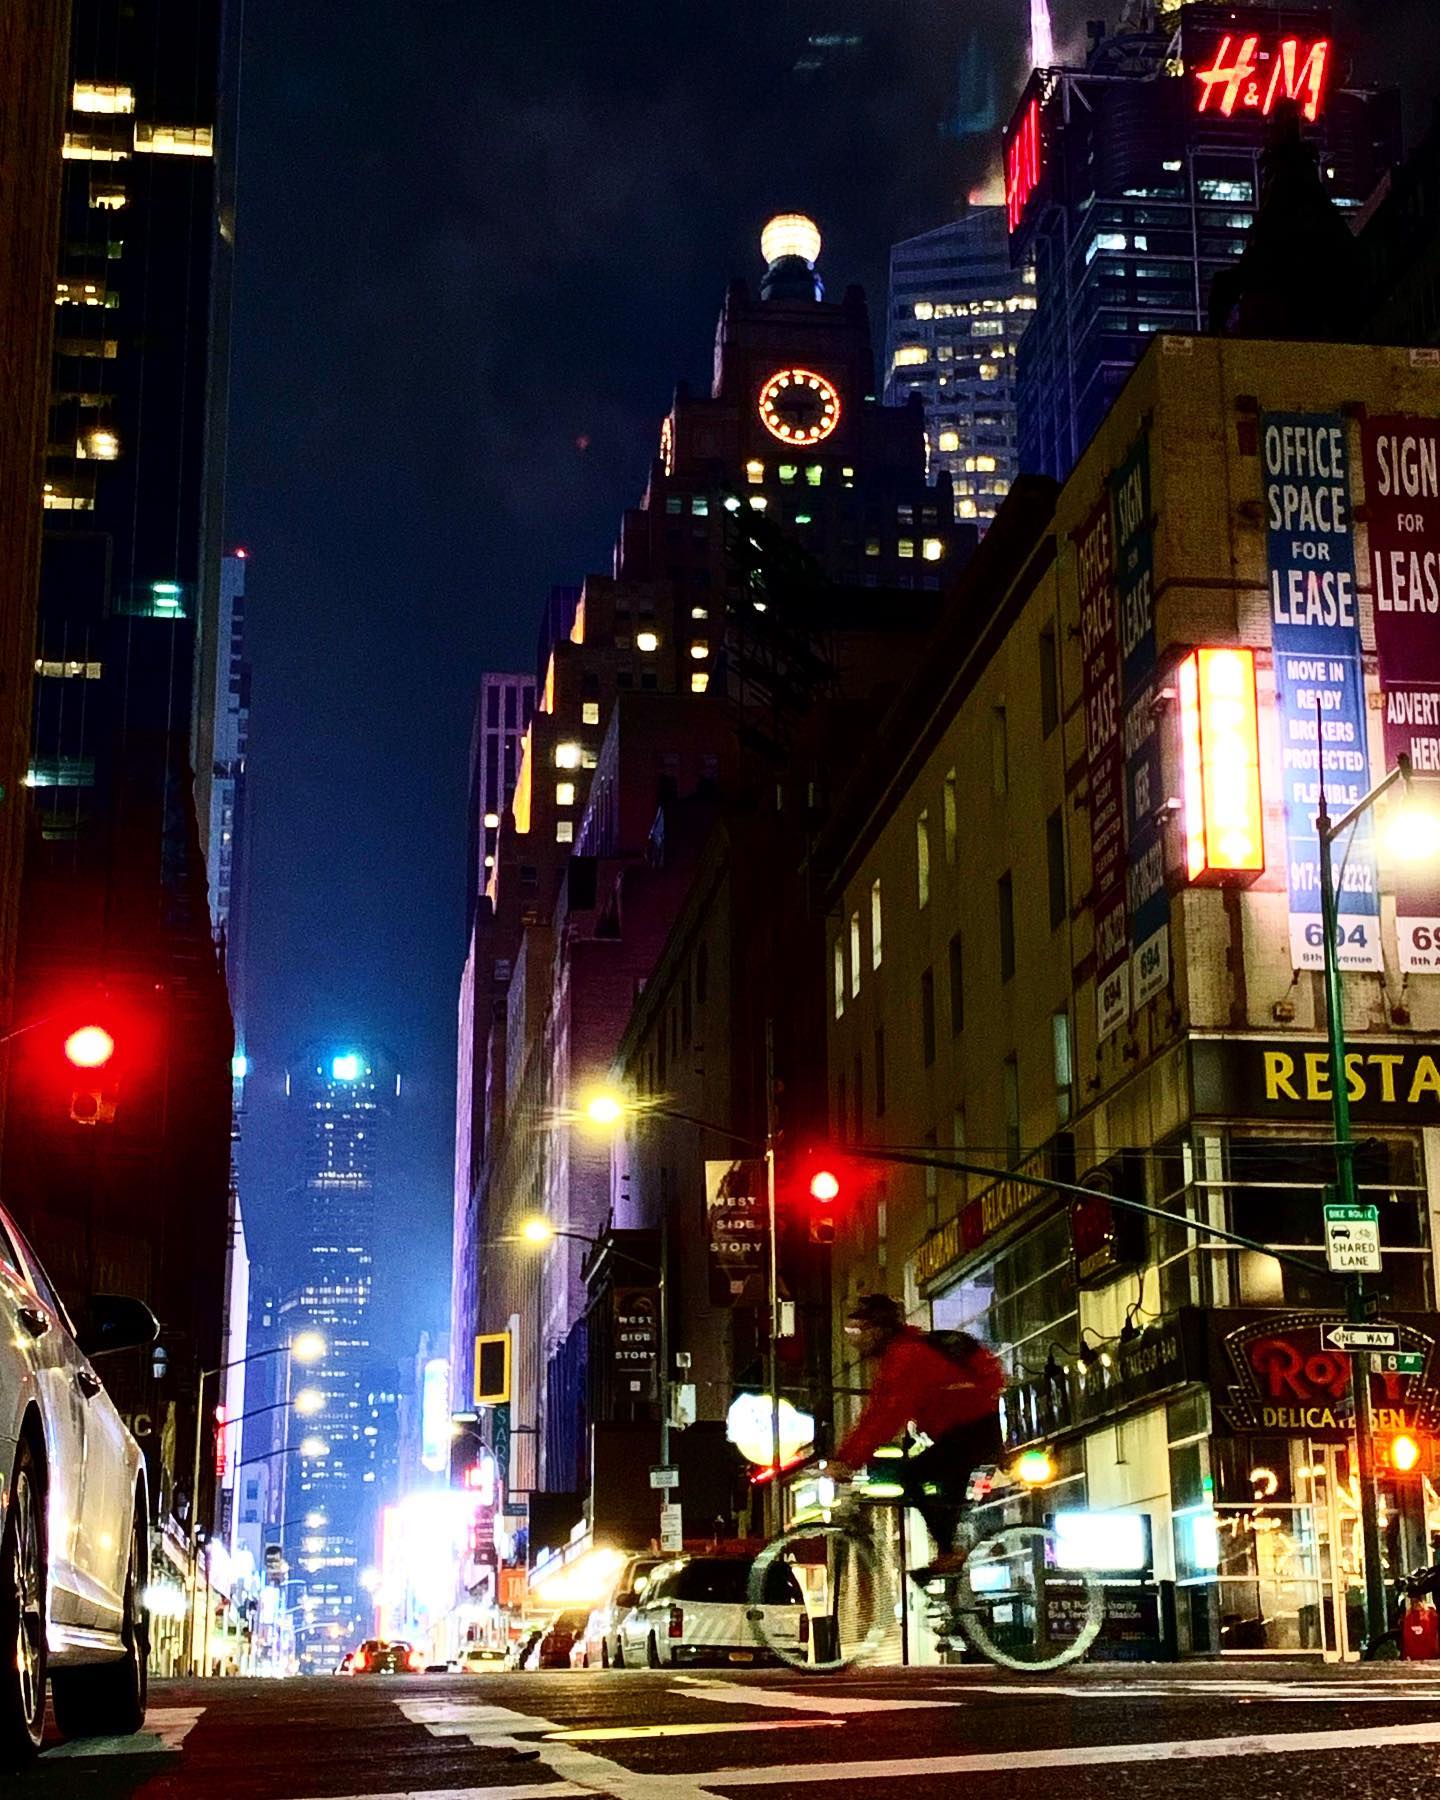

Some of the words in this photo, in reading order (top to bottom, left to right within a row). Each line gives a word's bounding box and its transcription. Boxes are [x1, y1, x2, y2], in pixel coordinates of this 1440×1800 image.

[1195, 36, 1328, 122] H&M
[1265, 424, 1344, 479] OFFICE
[1376, 435, 1440, 498] SIGN
[1119, 462, 1144, 546] SIGN
[1267, 484, 1347, 534] SPACE
[1397, 513, 1425, 533] FOR
[1291, 541, 1331, 561] FOR
[1375, 550, 1440, 614] LEAS
[1272, 569, 1355, 627] LEASE
[1121, 569, 1152, 660] LEASE
[1287, 660, 1326, 682] MOVE
[1329, 662, 1345, 682] IN
[1296, 689, 1342, 711] READY
[1289, 719, 1355, 742] BROKERS
[1283, 747, 1364, 772] PROTECTED
[1410, 737, 1440, 771] HER
[1290, 861, 1373, 893] 917-62232
[1335, 955, 1373, 964] venue
[1263, 1051, 1440, 1103] RESTA
[714, 1196, 757, 1208] WEST
[716, 1219, 755, 1230] SIDE
[709, 1242, 763, 1253] STORY
[1332, 1242, 1376, 1253] SHARED
[1340, 1255, 1369, 1266] LANE
[618, 1315, 654, 1325] WEST
[1335, 1333, 1355, 1342] ONE
[1367, 1334, 1390, 1343] WAY
[614, 1351, 657, 1361] STORY
[1388, 1354, 1398, 1370] 8
[1262, 1407, 1406, 1429] DELICATESEN
